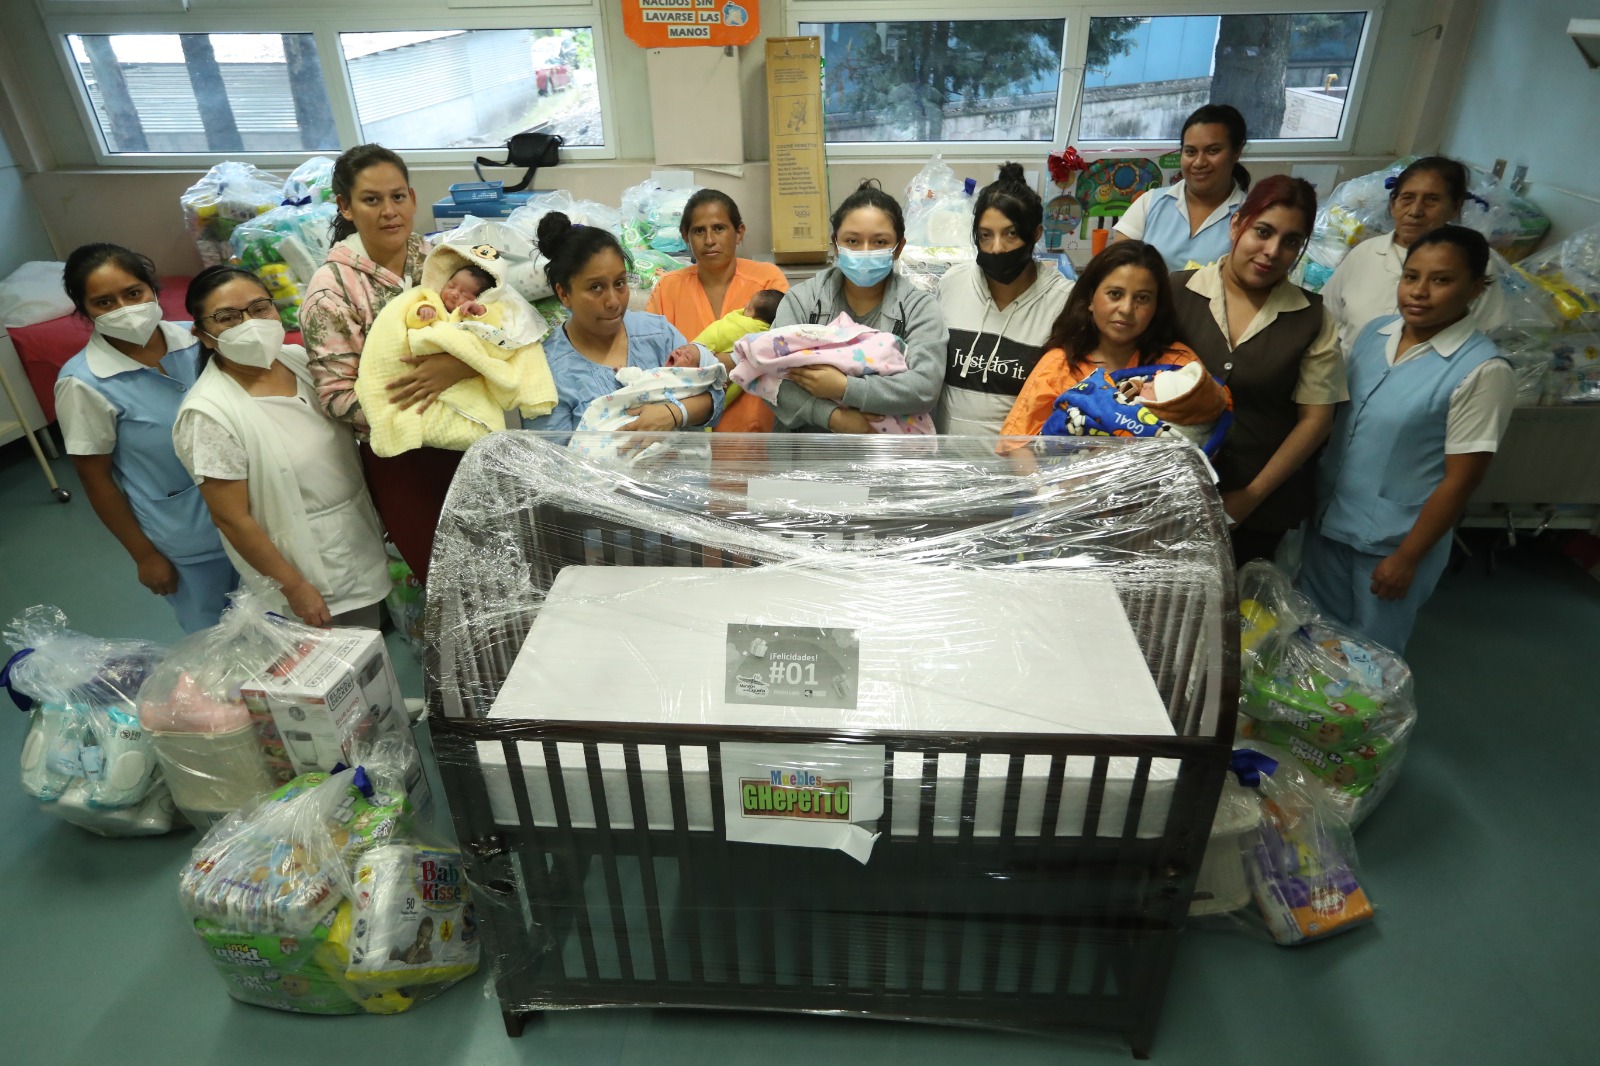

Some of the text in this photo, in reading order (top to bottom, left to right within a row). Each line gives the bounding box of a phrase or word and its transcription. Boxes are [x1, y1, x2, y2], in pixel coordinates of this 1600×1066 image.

[645, 12, 720, 22] LAVARSE LAS
[669, 28, 708, 37] MANOS
[987, 356, 1008, 375] do
[1011, 362, 1026, 380] it.
[1114, 412, 1144, 435] GOAL
[769, 652, 818, 662] ¡Felicidades!
[768, 661, 819, 686] #01
[329, 679, 349, 700] BLACK
[331, 682, 353, 707] DECKER
[770, 770, 822, 786] Muebles
[406, 897, 415, 910] 50
